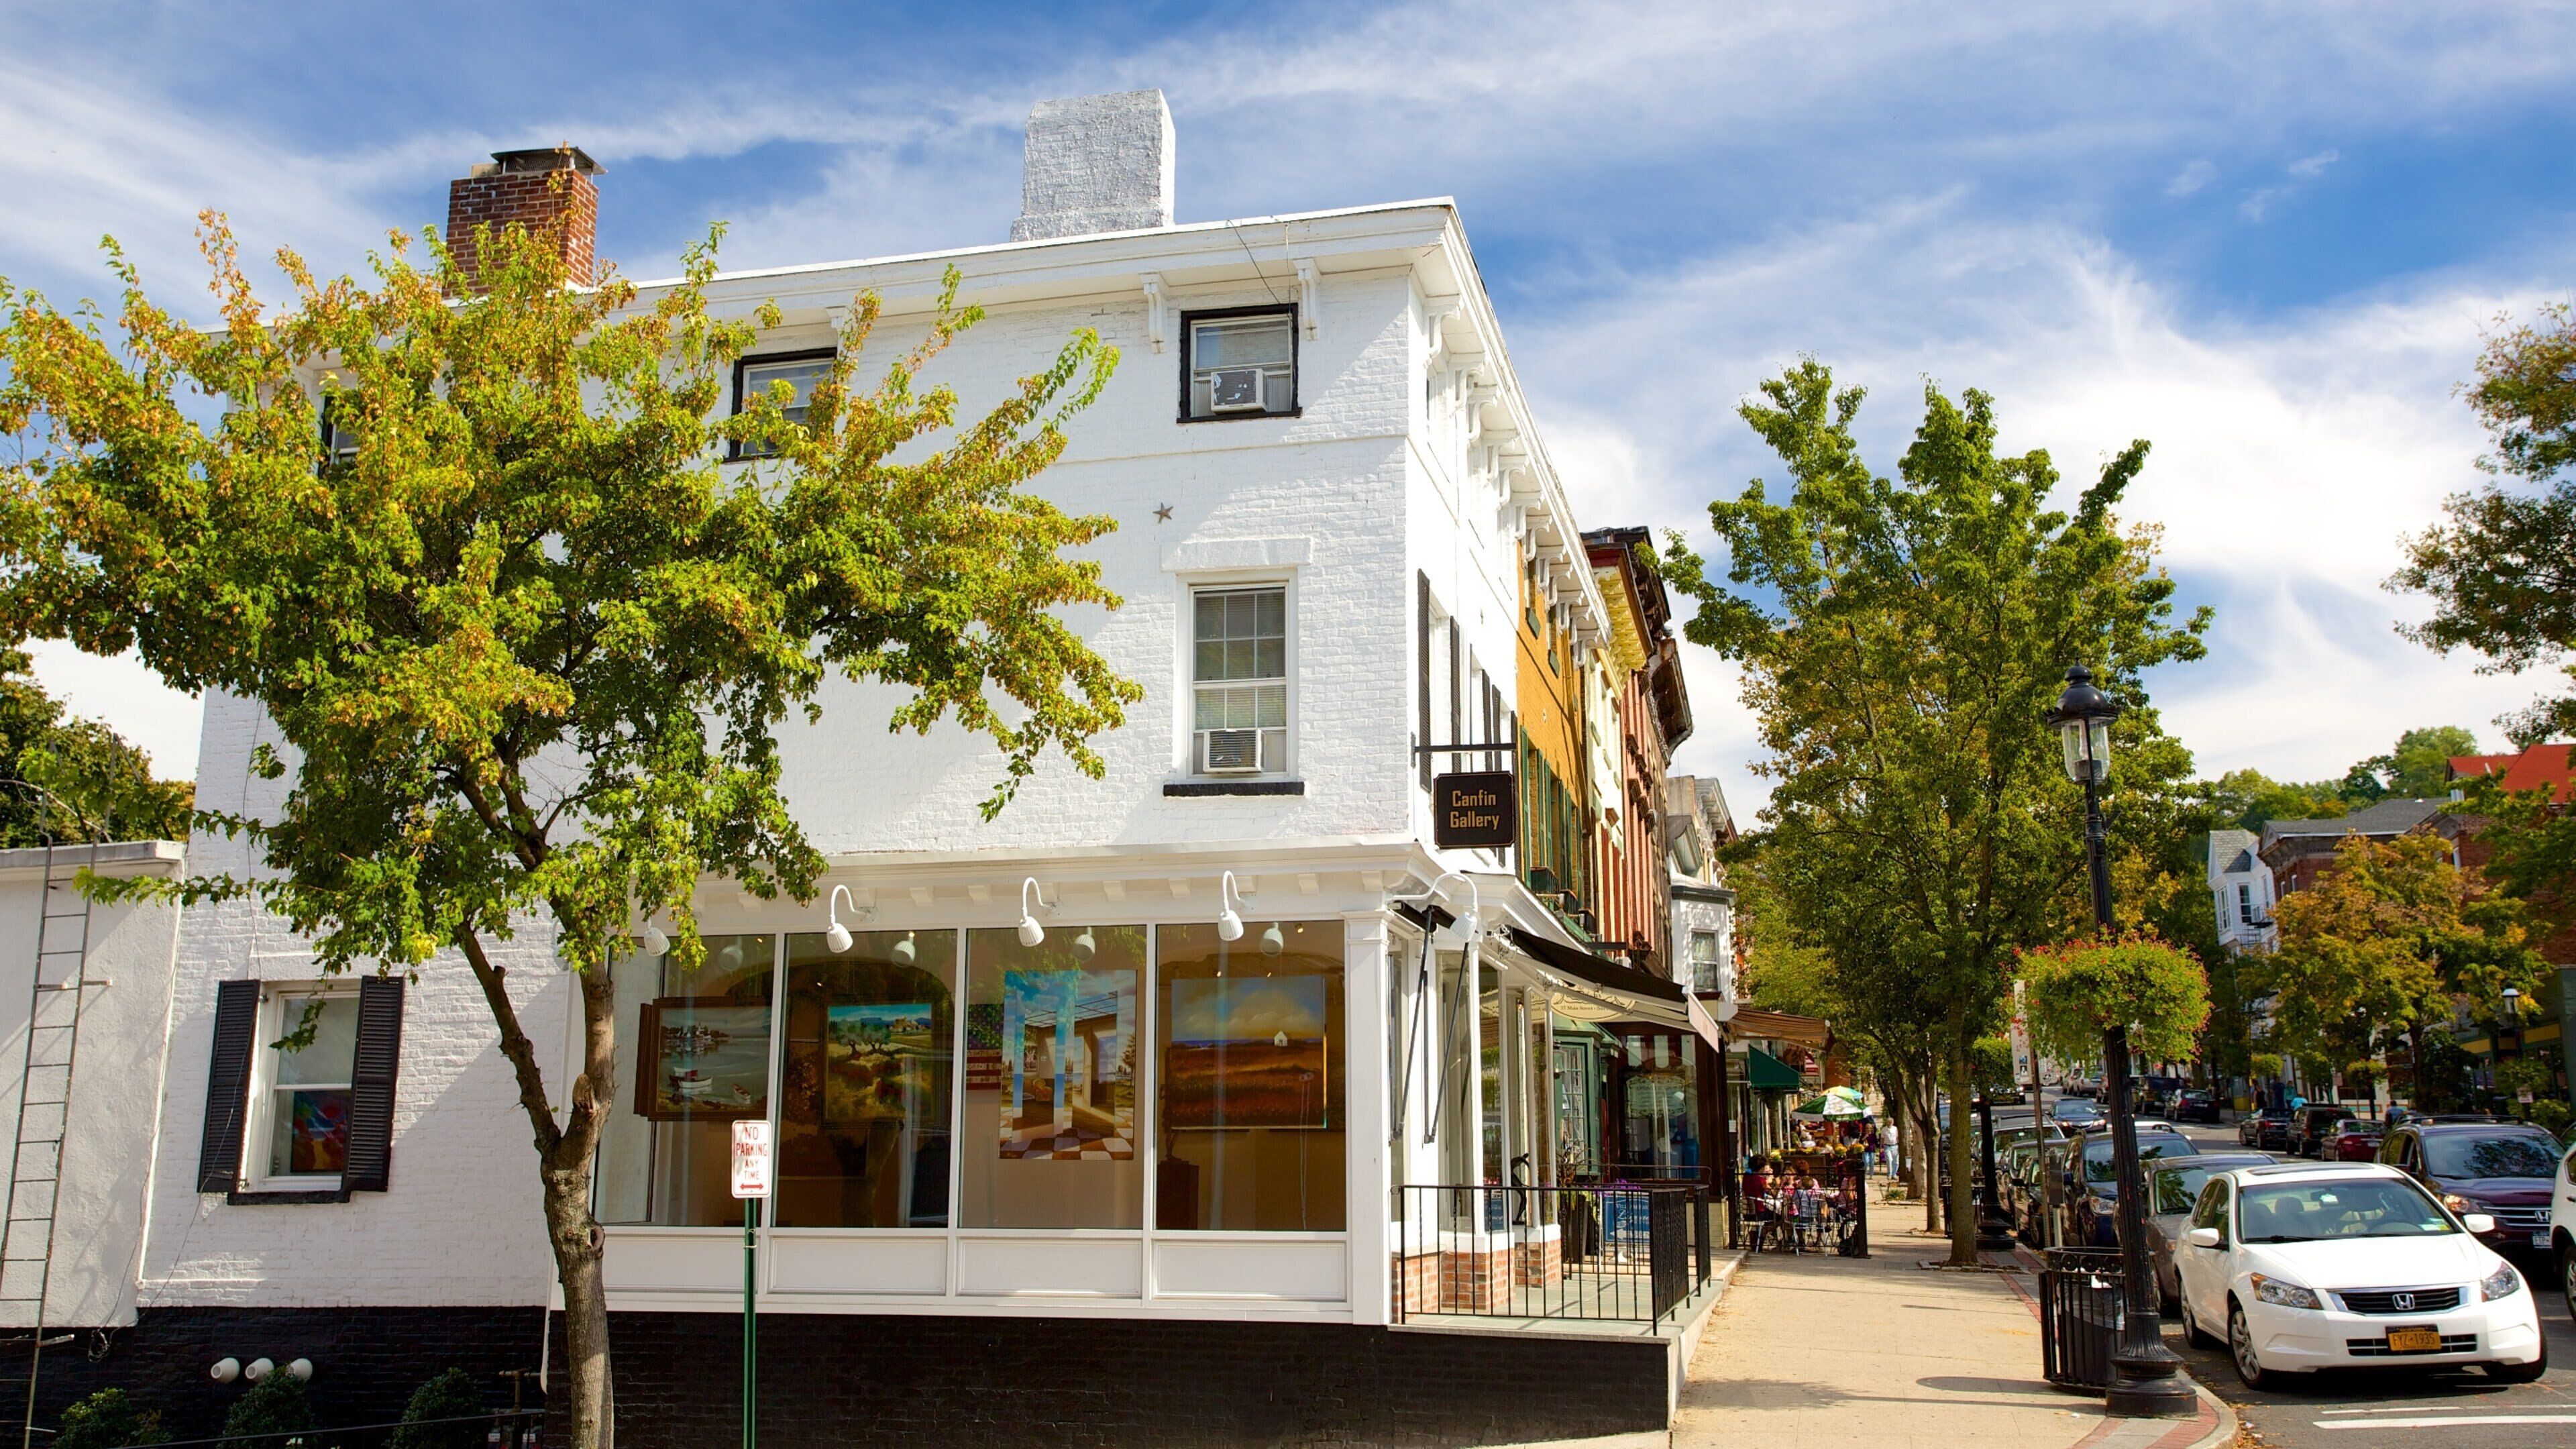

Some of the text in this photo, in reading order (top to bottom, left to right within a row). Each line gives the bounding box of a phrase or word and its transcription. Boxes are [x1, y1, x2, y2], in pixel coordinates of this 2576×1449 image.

[1452, 789, 1497, 807] Canfin
[1450, 810, 1500, 830] Gallery
[745, 1126, 759, 1140] NO
[735, 1142, 767, 1157] PARKING
[745, 1159, 759, 1168] ANY
[744, 1170, 759, 1181] TIME
